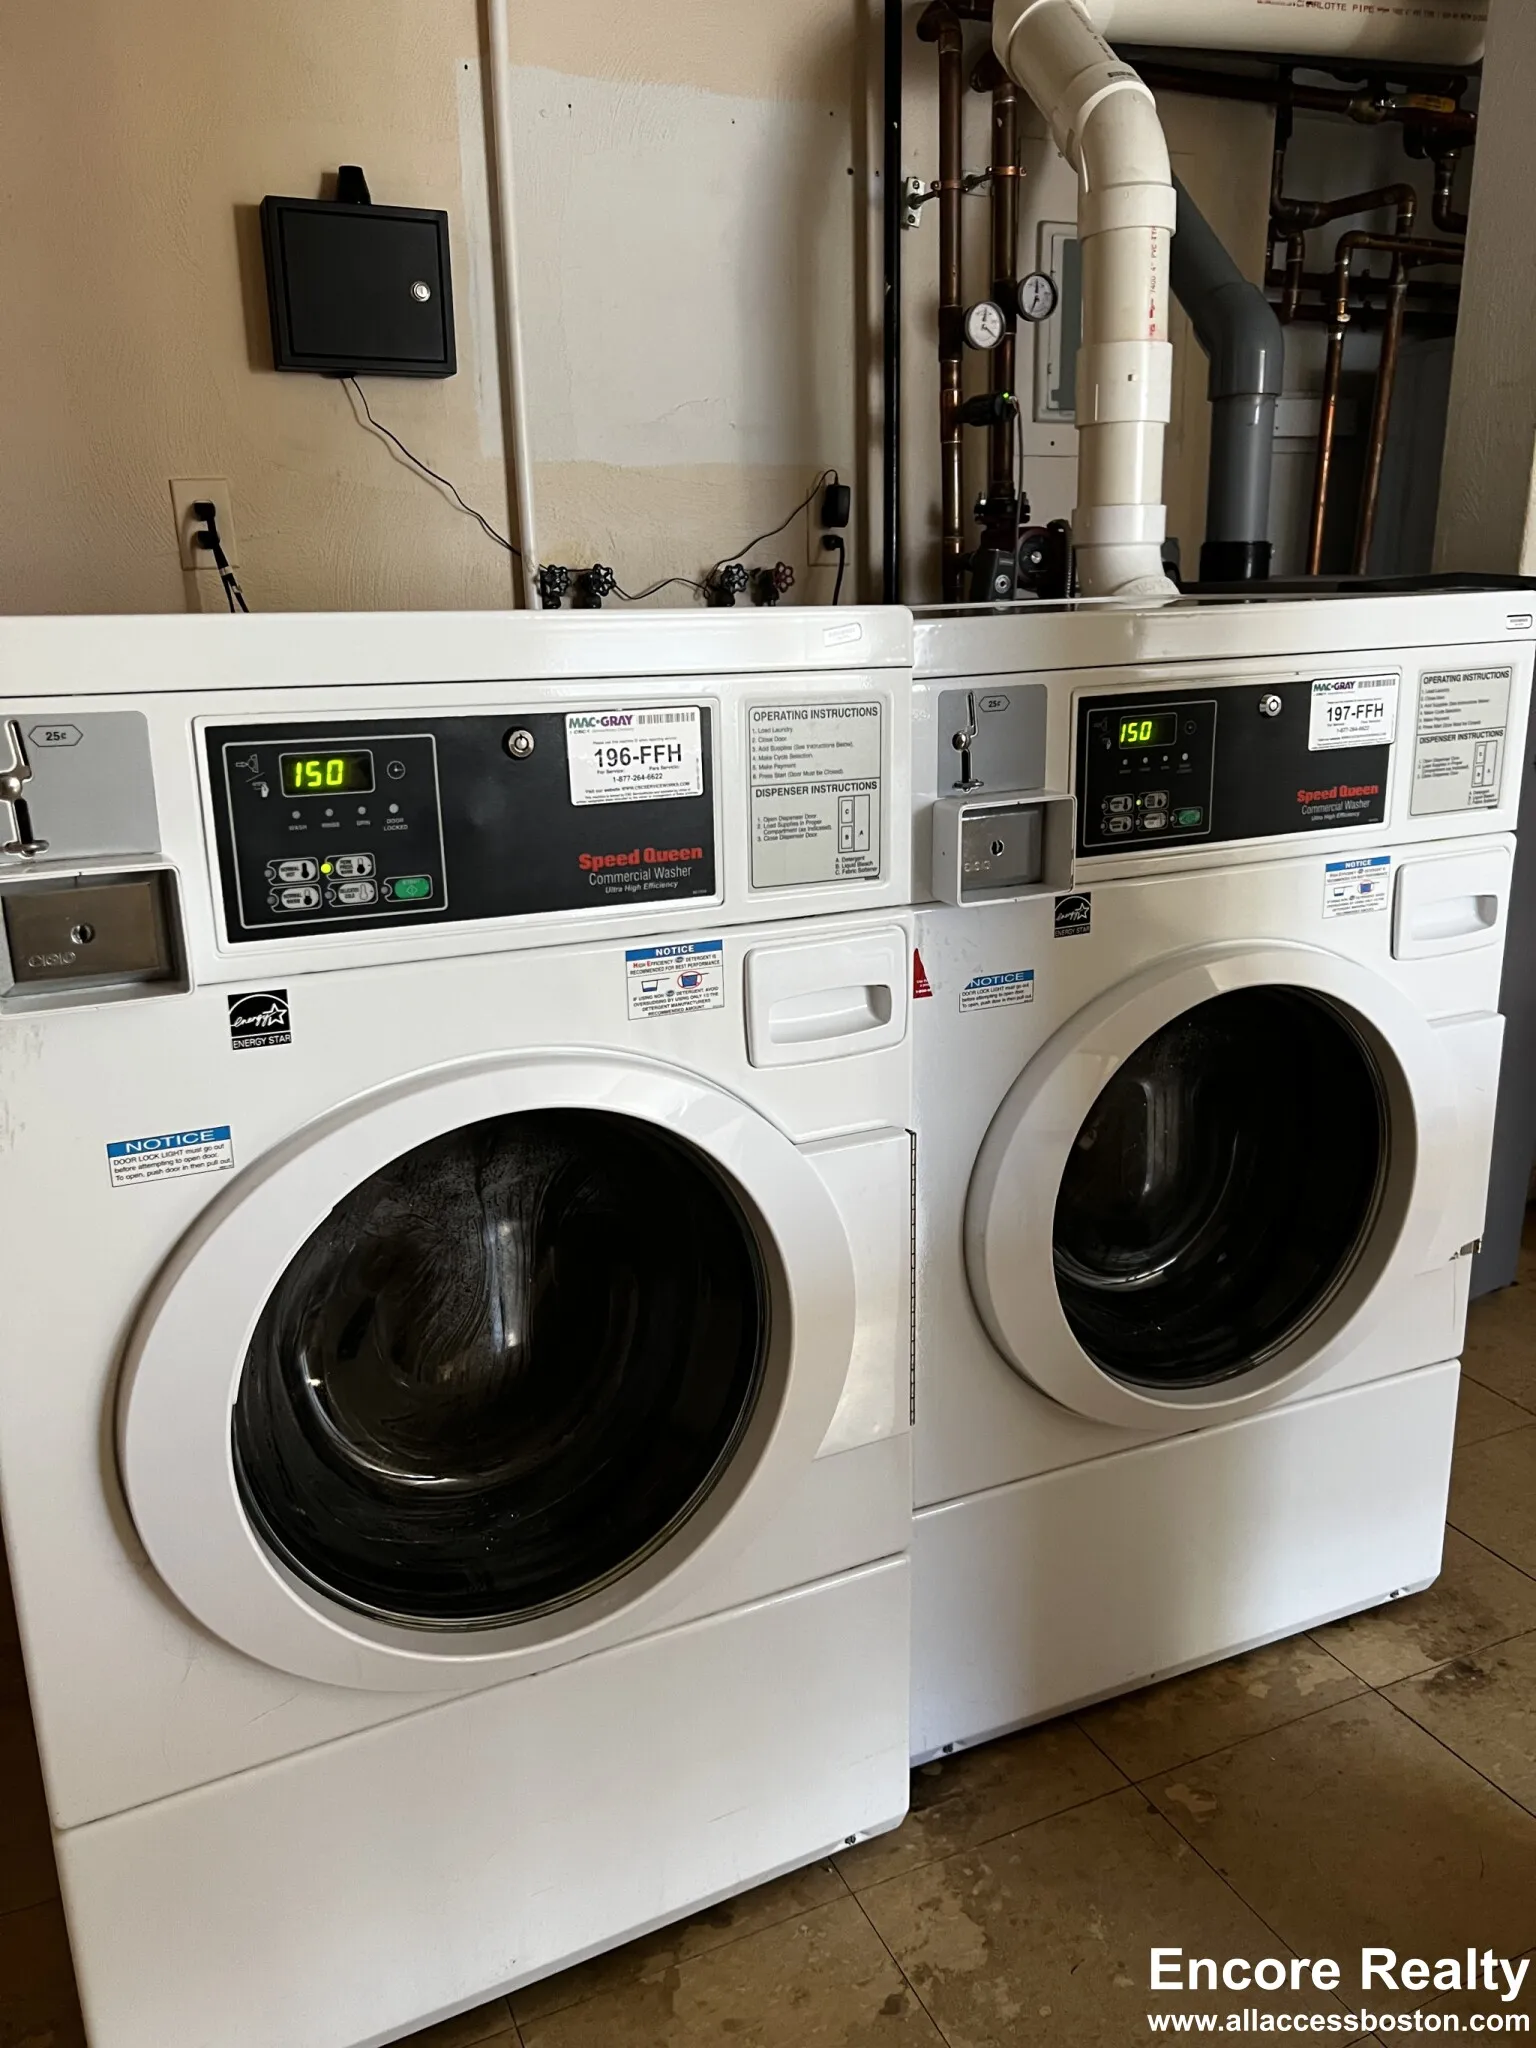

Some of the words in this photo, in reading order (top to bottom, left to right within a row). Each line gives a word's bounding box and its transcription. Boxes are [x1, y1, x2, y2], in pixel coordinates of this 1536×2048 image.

[1352, 4, 1375, 14] PIPE
[1423, 675, 1461, 685] OPERATING
[1462, 670, 1510, 682] INSTRUCTIONS
[753, 710, 808, 721] OPERATING
[810, 706, 878, 719] INSTRUCTIONS
[1327, 703, 1384, 722] 197-FFH
[45, 731, 68, 742] 25¢
[1120, 721, 1152, 743] 150
[1419, 734, 1456, 744] DISPENSER
[1457, 730, 1504, 741] INSTRUCTIONS
[594, 744, 682, 767] 196-FFH
[295, 759, 344, 788] 150
[613, 772, 663, 783] 1-877-264-6622
[755, 786, 809, 798] DISPENSER
[811, 781, 878, 795] INSTRUCTIONS
[1297, 786, 1337, 804] Speed
[1339, 785, 1379, 798] Queen
[1301, 801, 1343, 815] Commercial
[1344, 800, 1371, 810] Washer
[579, 848, 640, 872] Speed
[643, 847, 703, 864] Queen
[1345, 860, 1372, 869] NOTICE
[589, 868, 652, 886] Commercial
[653, 865, 692, 880] Washer
[605, 886, 623, 894] Ultra
[624, 884, 642, 893] High
[643, 881, 679, 891] Efficiency
[1055, 929, 1075, 937] ENERGY
[655, 945, 695, 956] NOTICE
[970, 972, 1024, 988] NOTICE
[233, 1037, 267, 1049] ENERGY
[268, 1034, 291, 1045] STAR
[125, 1130, 216, 1153] NOTICE
[114, 1157, 137, 1166] DOOR
[139, 1154, 160, 1163] LOCK
[161, 1150, 183, 1159] LIGHT
[114, 1166, 137, 1174] before
[138, 1160, 174, 1170] attempting
[185, 1156, 201, 1164] open
[147, 1169, 164, 1177] push
[166, 1166, 182, 1174] door
[207, 1160, 219, 1168] pull
